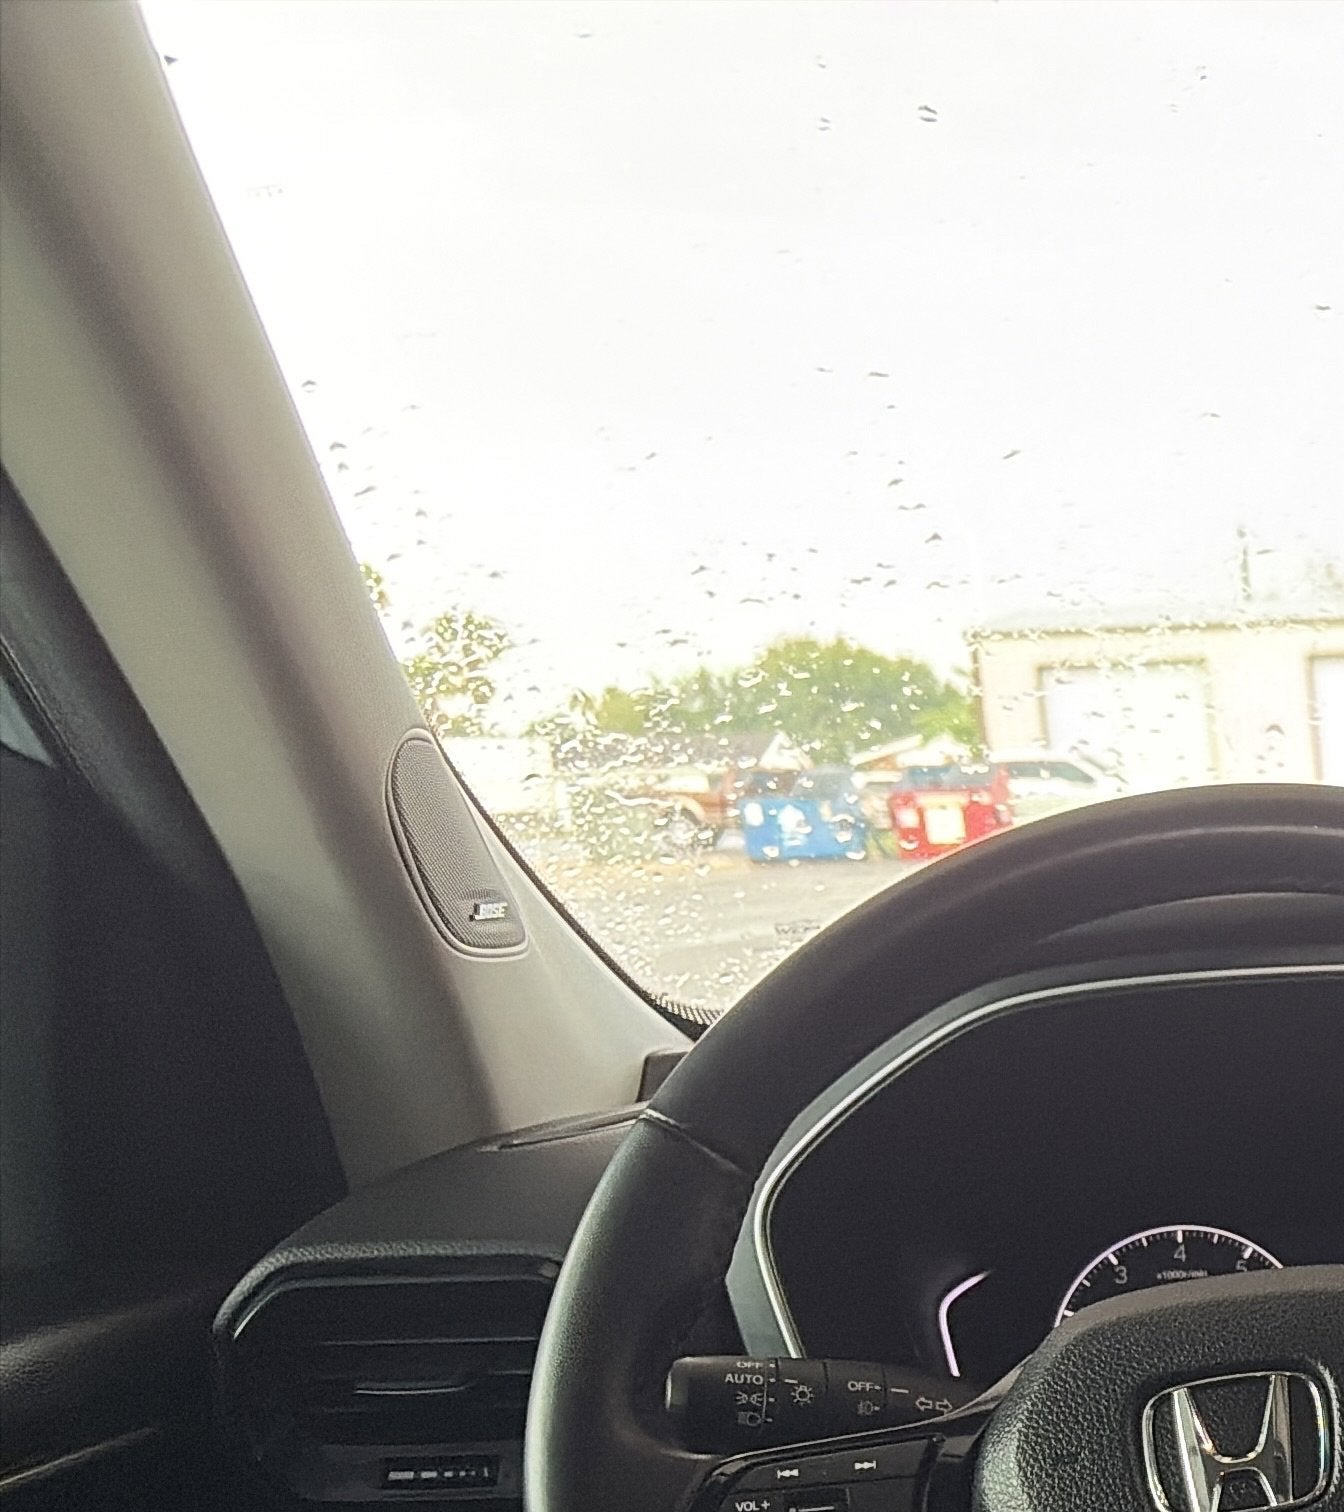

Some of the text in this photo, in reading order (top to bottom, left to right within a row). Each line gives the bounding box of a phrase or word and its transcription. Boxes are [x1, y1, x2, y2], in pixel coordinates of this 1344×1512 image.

[1173, 1244, 1187, 1262] 4
[1113, 1265, 1128, 1285] 3
[724, 1373, 764, 1386] AUTO
[847, 1380, 875, 1393] OFF
